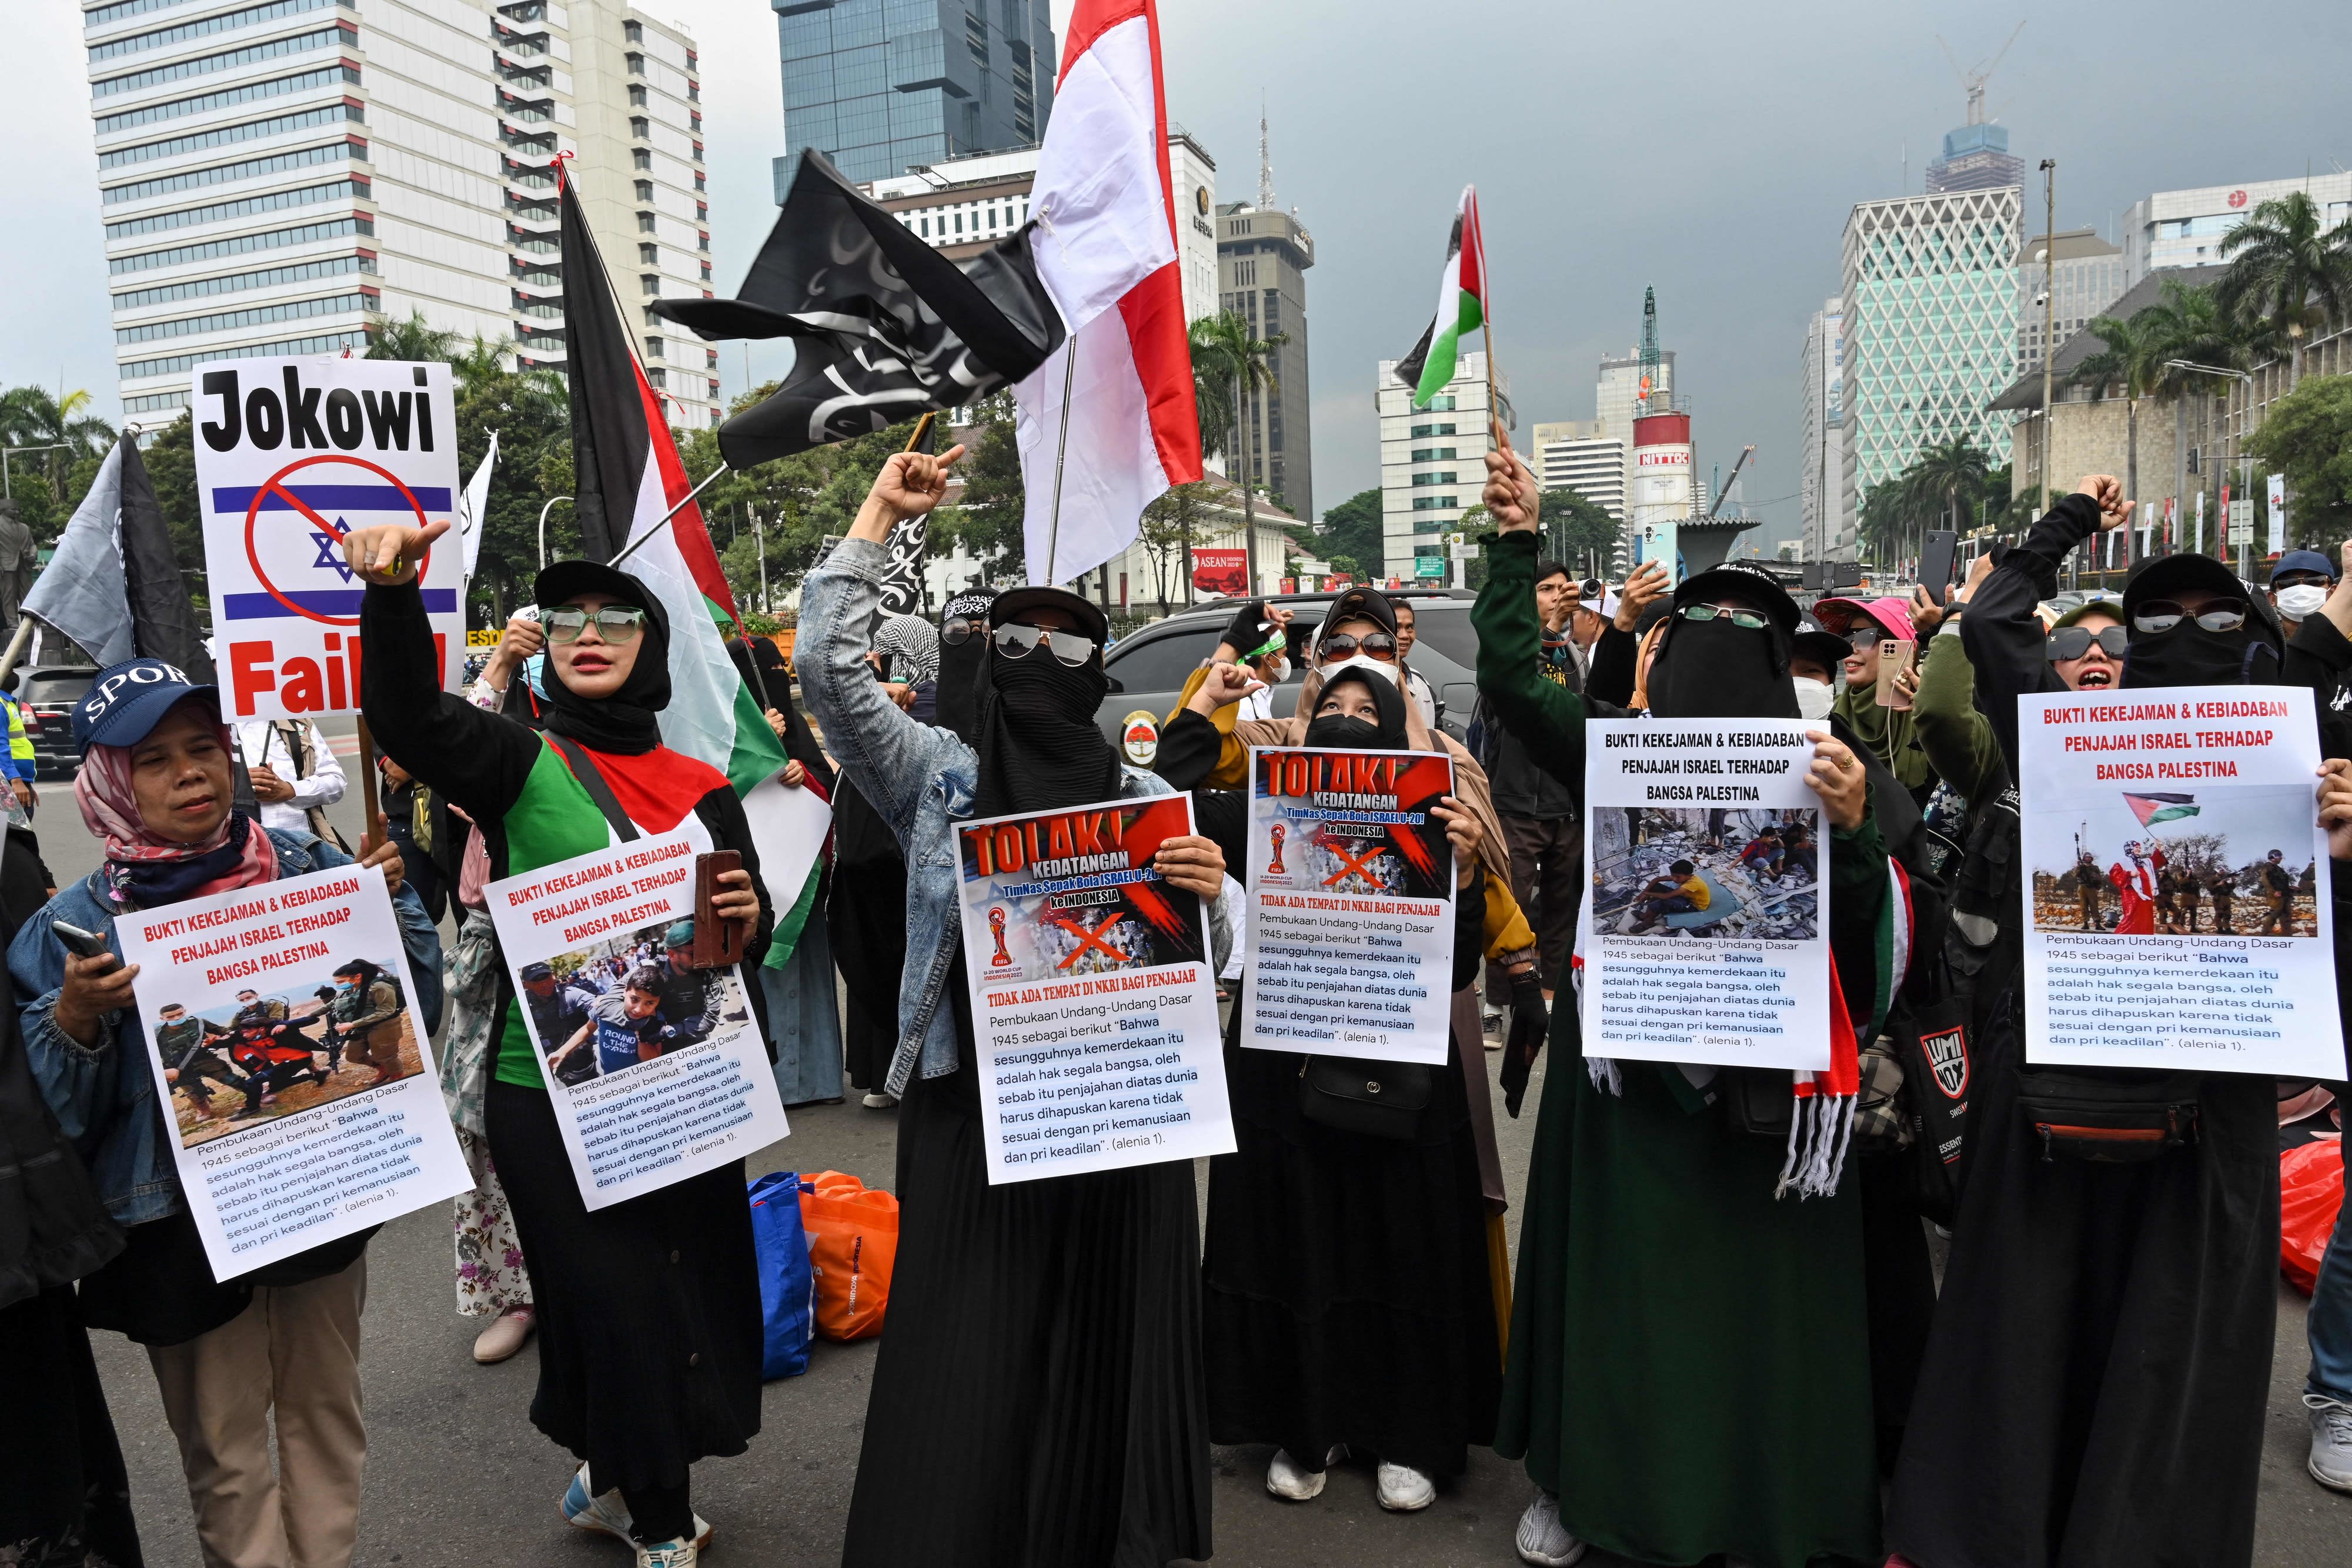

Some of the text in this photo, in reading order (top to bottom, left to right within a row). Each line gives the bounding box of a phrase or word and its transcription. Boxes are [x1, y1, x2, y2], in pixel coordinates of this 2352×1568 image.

[1194, 215, 1212, 239] ESDM
[201, 366, 434, 452] Jokowi
[1642, 453, 1688, 464] NITTOC
[1200, 557, 1227, 567] ASEAN
[85, 664, 192, 724] SPOR
[2043, 701, 2287, 724] BUKTI KEKEJAMAN & KEBIADABAN
[1605, 733, 1804, 748] BUKTI KEKEJAMAN & KEBIADABAN
[2064, 730, 2273, 752] PENJAJAH ISRAEL TERHADAP
[1259, 755, 1396, 797] TOLAK!
[1622, 759, 1789, 774] PENJAJAH ISRAEL TERHADAP
[2096, 760, 2237, 780] BANGSA PALESTINA
[1314, 792, 1398, 810] KEDATANGAN
[1646, 785, 1759, 801] BANGSA PALESTINA
[1287, 808, 1424, 824] TimNas Sepak Bola ISRAEL U-20!
[968, 810, 1122, 876] TOLAK!
[1325, 824, 1384, 837] ke INDONESIA
[507, 841, 691, 907] BUKTI KEKEJAMAN & KEBIADABAN
[1033, 851, 1130, 879] KEDATANGAN
[532, 867, 686, 926] PENJAJAH ISRAEL TERHADAP
[1003, 881, 1042, 898] TimNas
[1044, 877, 1076, 893] Sepak
[1077, 875, 1100, 889] Bola
[1100, 871, 1134, 887] ISRAEL
[143, 877, 360, 942] BUKTI KEKEJAMAN & KEBIADABAN
[1050, 889, 1119, 910] ke INDONESIA
[1259, 894, 1440, 916] TIDAK ADA TEMPAT DI NKRI BAGI PENJAJAH
[563, 898, 671, 942] BANGSA PALESTINA
[171, 907, 350, 965] PENJAJAH ISRAEL TERHADAP
[1602, 937, 1799, 951] Pembukaan Undang-Undang Dasar
[2046, 934, 2294, 950] Pembukaan Undang-Undang Dasar
[206, 940, 329, 985] BANGSA PALESTINA
[987, 968, 1196, 1007] TIDAK ADA TEMPAT DI NKRI BAGI PENJAJAH
[990, 994, 1192, 1028] Pembukaan Undang-Undang Dasar
[605, 1029, 636, 1044] ROUND
[610, 1039, 628, 1048] THE
[991, 1033, 1018, 1047] 1945
[1021, 1027, 1067, 1043] sebagai
[1070, 1022, 1112, 1037] berikut
[994, 1032, 1184, 1066] sesungguhnya kemerdekaan itu
[996, 1051, 1181, 1085] adalah hak segala bangsa, oleh
[998, 1069, 1198, 1105] sebab itu penjajahan diatas dunia
[1000, 1090, 1183, 1124] harus dihapuskan karena tidak
[1002, 1111, 1191, 1144] sesuai dengan pri kemanusiaan
[1004, 1151, 1027, 1164] dan
[1030, 1146, 1047, 1164] pri
[1112, 1135, 1150, 1151] (alenia
[848, 1236, 862, 1316] YOSHINOYA INDONESIA
